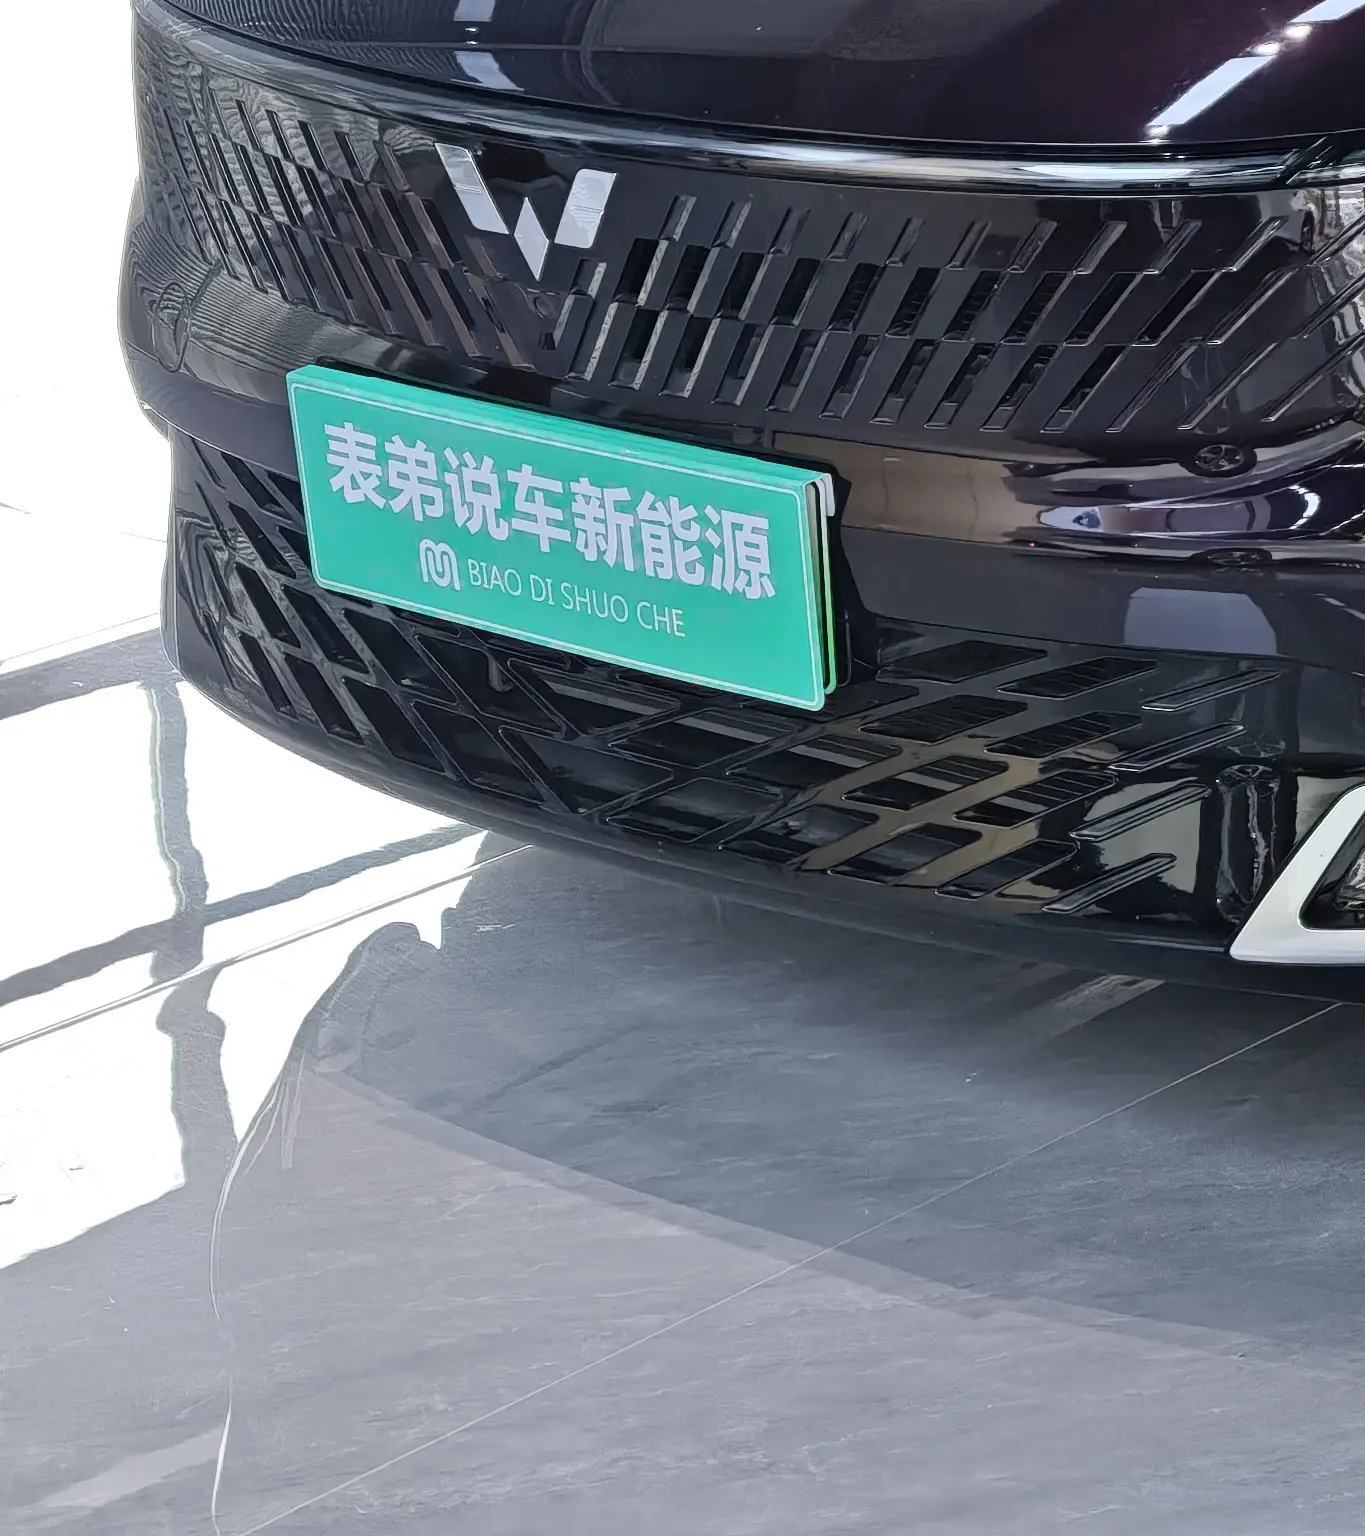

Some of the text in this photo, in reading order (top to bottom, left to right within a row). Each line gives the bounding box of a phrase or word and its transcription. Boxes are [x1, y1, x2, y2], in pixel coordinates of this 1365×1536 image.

[324, 421, 776, 600] 表弟说车新能源
[467, 558, 687, 638] BIAO DI SHUO CHE
